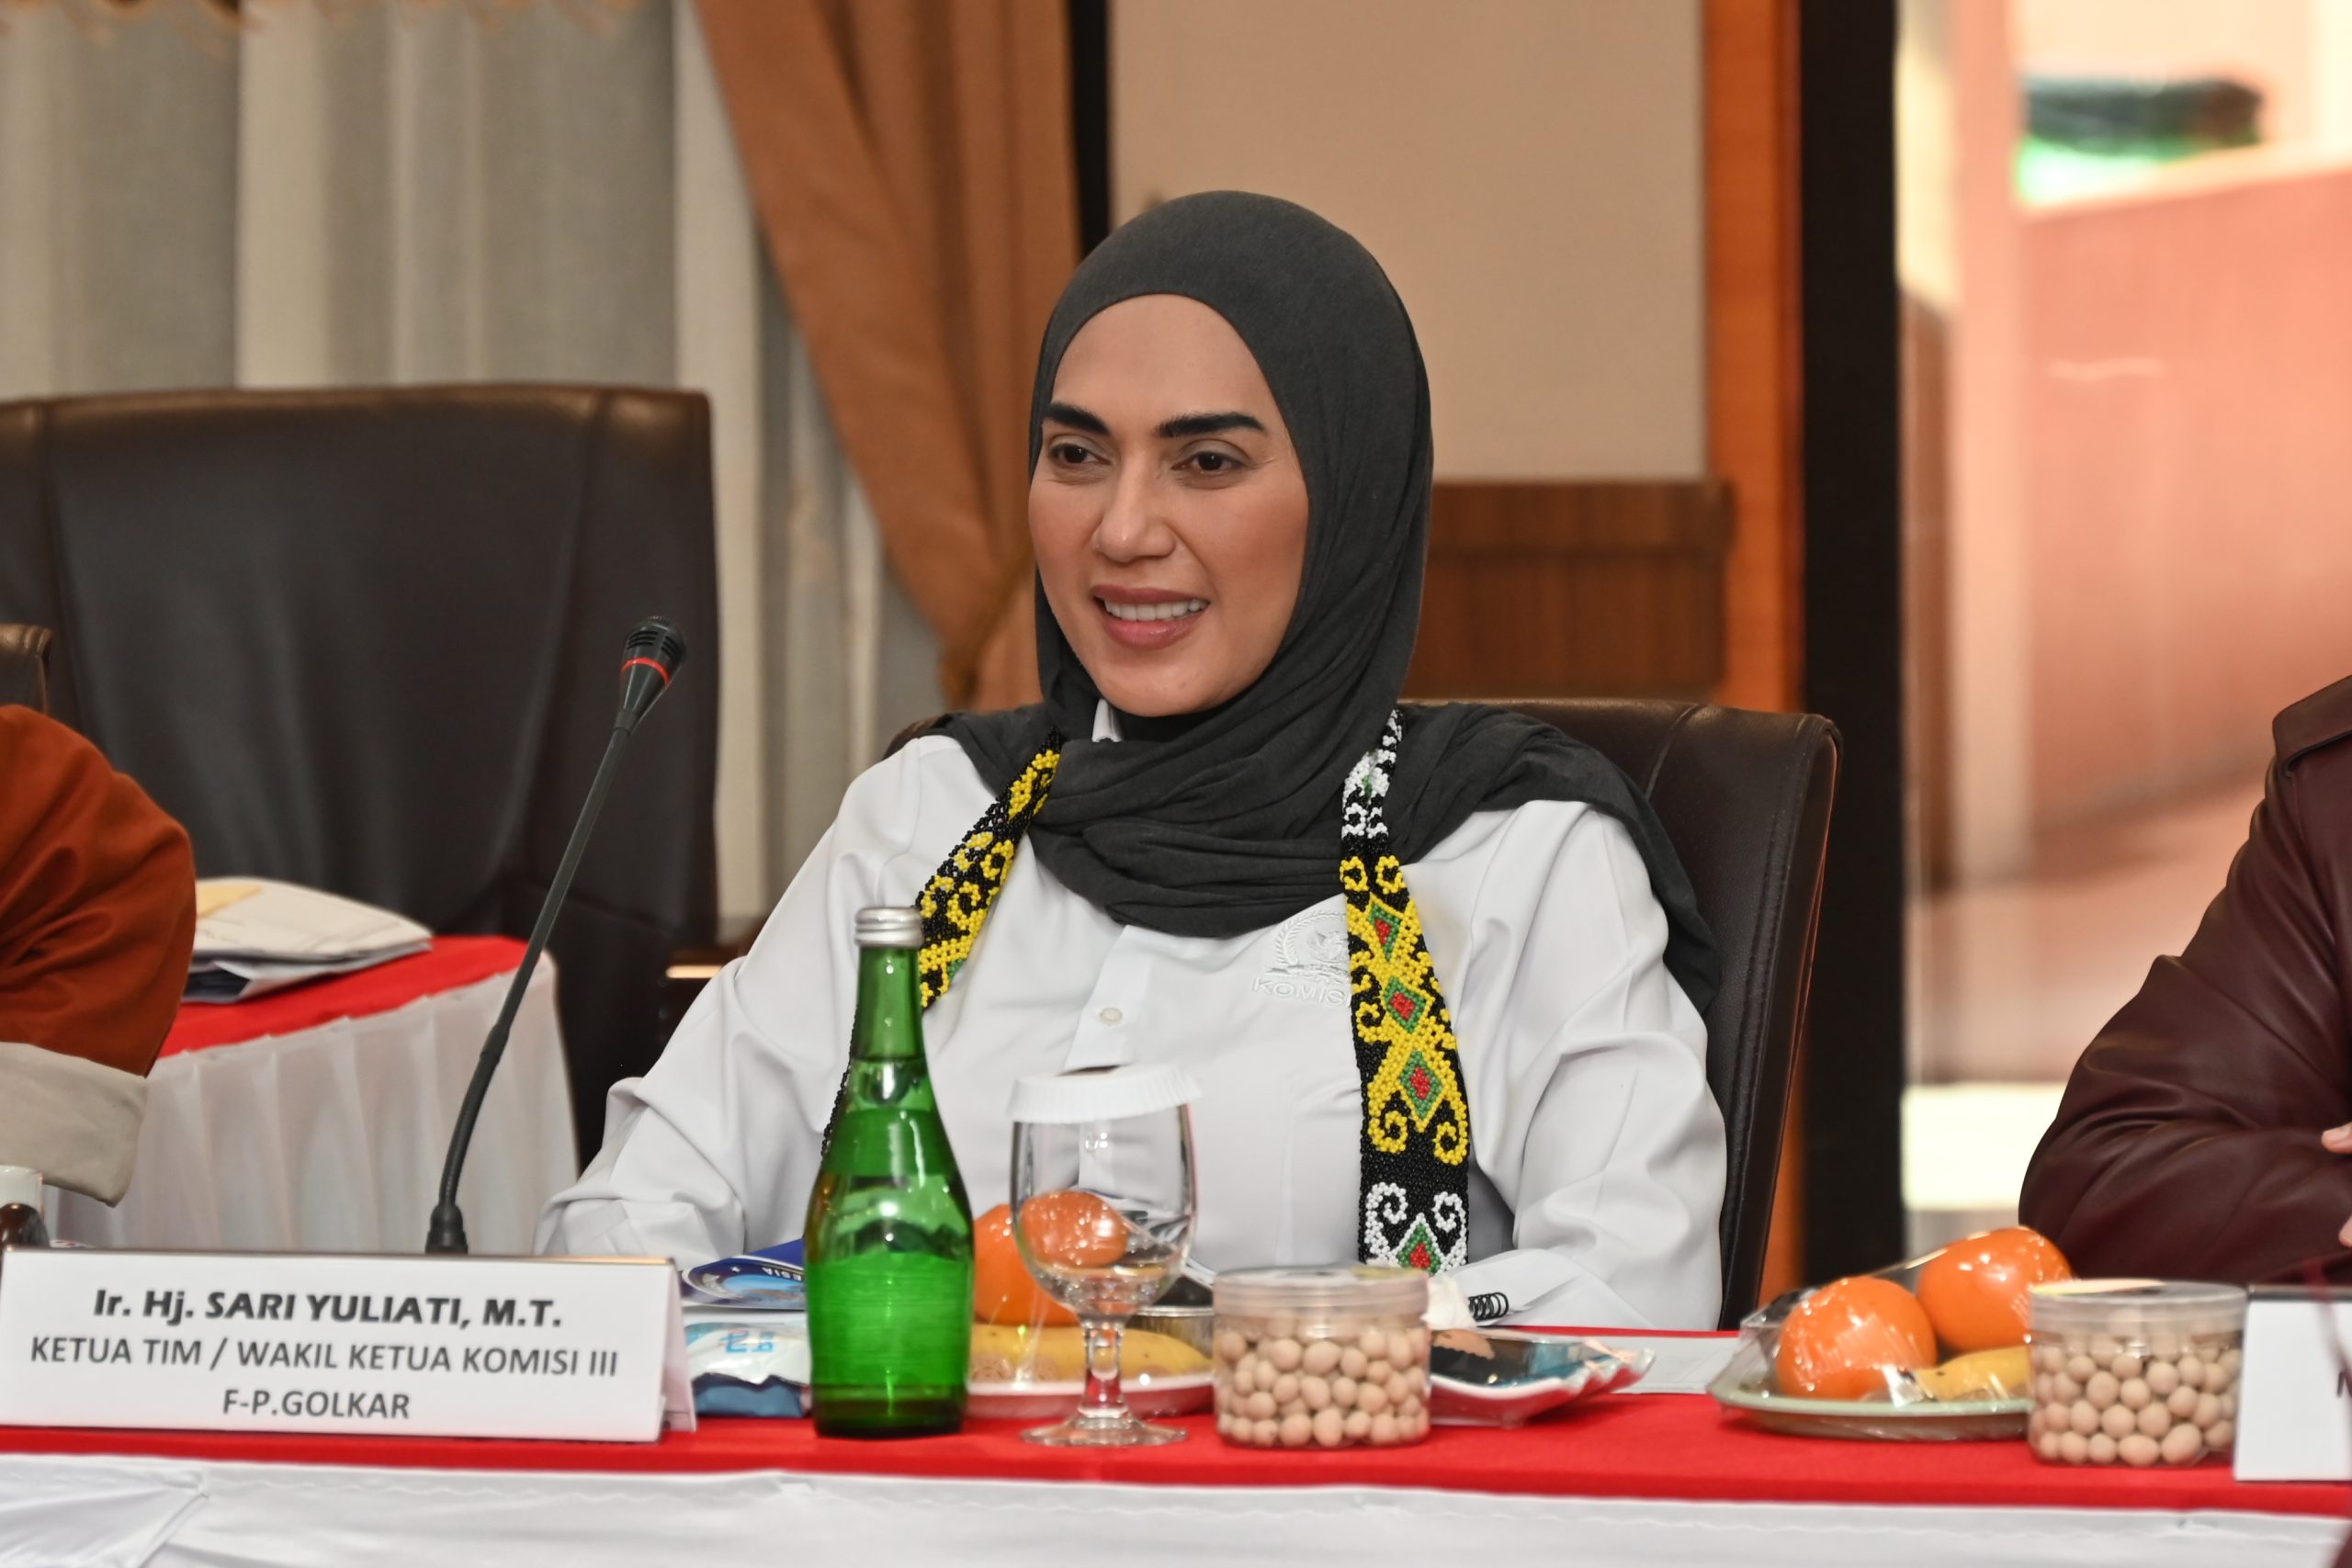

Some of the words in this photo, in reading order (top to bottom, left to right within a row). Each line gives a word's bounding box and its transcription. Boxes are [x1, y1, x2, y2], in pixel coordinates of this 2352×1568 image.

[94, 1289, 131, 1317] Ir.
[143, 1290, 194, 1326] Hj.
[205, 1292, 296, 1320] SARI
[307, 1294, 470, 1329] YULIATI,
[482, 1298, 561, 1328] M.T.
[31, 1337, 131, 1364] KETUA
[143, 1339, 201, 1365] TIM
[210, 1337, 228, 1371] /
[237, 1341, 337, 1370] WAKIL
[349, 1345, 450, 1371] KETUA
[463, 1348, 578, 1374] KOMISI
[590, 1351, 617, 1377] III
[223, 1389, 410, 1419] F-P.GOLKAR
